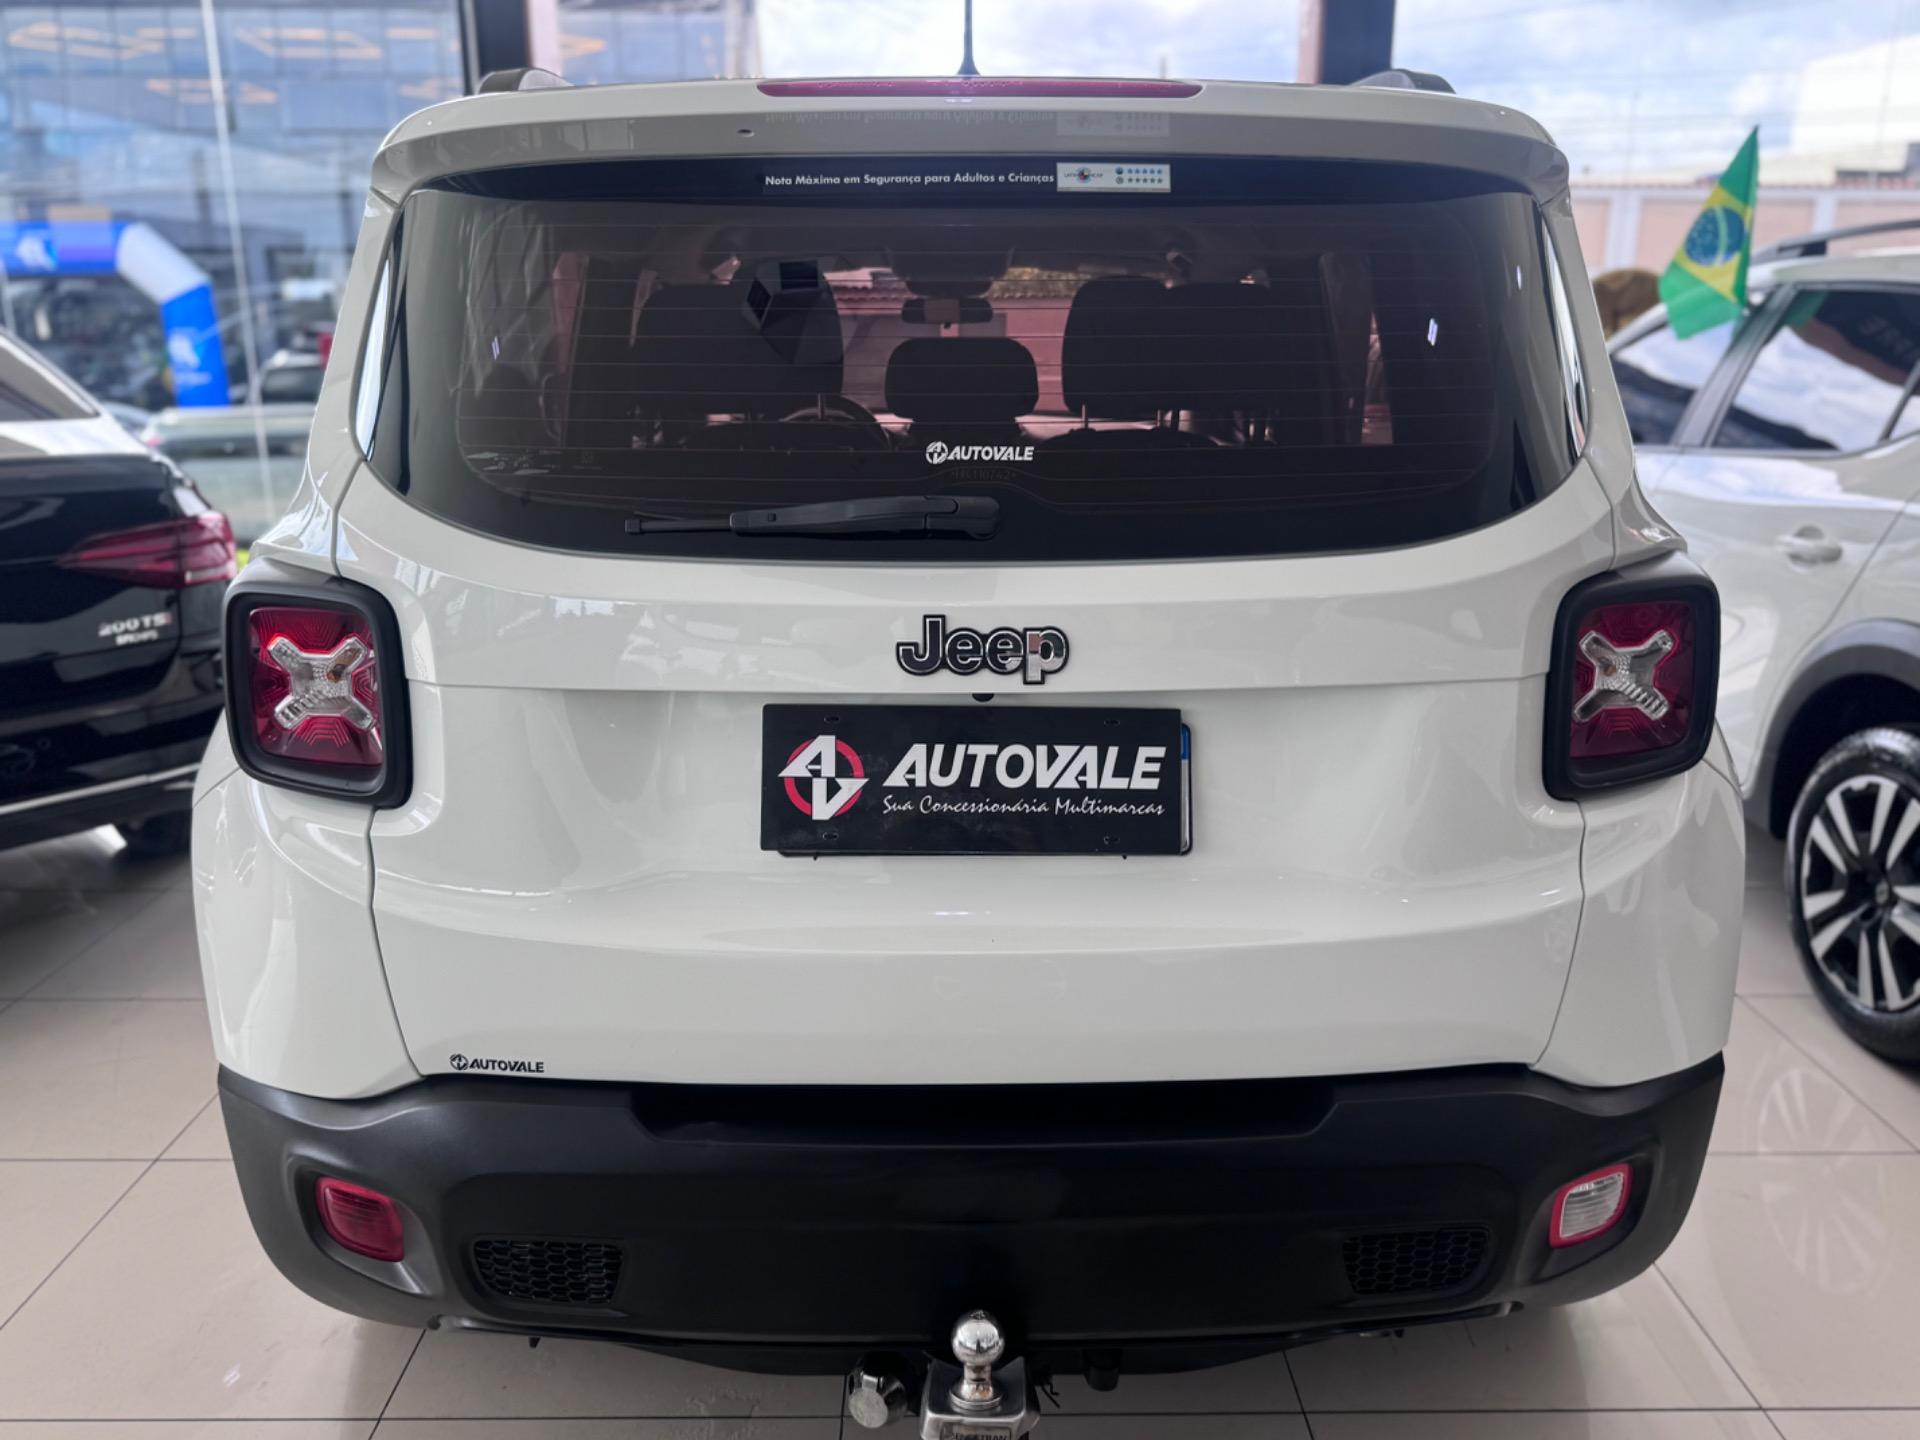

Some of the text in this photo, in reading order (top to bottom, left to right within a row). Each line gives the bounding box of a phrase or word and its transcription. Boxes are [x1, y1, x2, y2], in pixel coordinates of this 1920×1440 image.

[765, 175, 793, 186] Nota
[795, 173, 841, 186] Máxima
[843, 176, 861, 184] em
[863, 173, 922, 187] Segurança
[925, 174, 951, 185] para
[953, 172, 995, 183] Adultos
[998, 175, 1006, 183] e
[1007, 172, 1055, 185] Crianças
[947, 445, 1035, 461] AUTOVALE
[896, 614, 1070, 685] Jeep
[881, 743, 1167, 790] AUTOVALE
[882, 794, 1166, 815] Sua Concessionária Multimarcas
[469, 1058, 545, 1073] AUTOVALE
